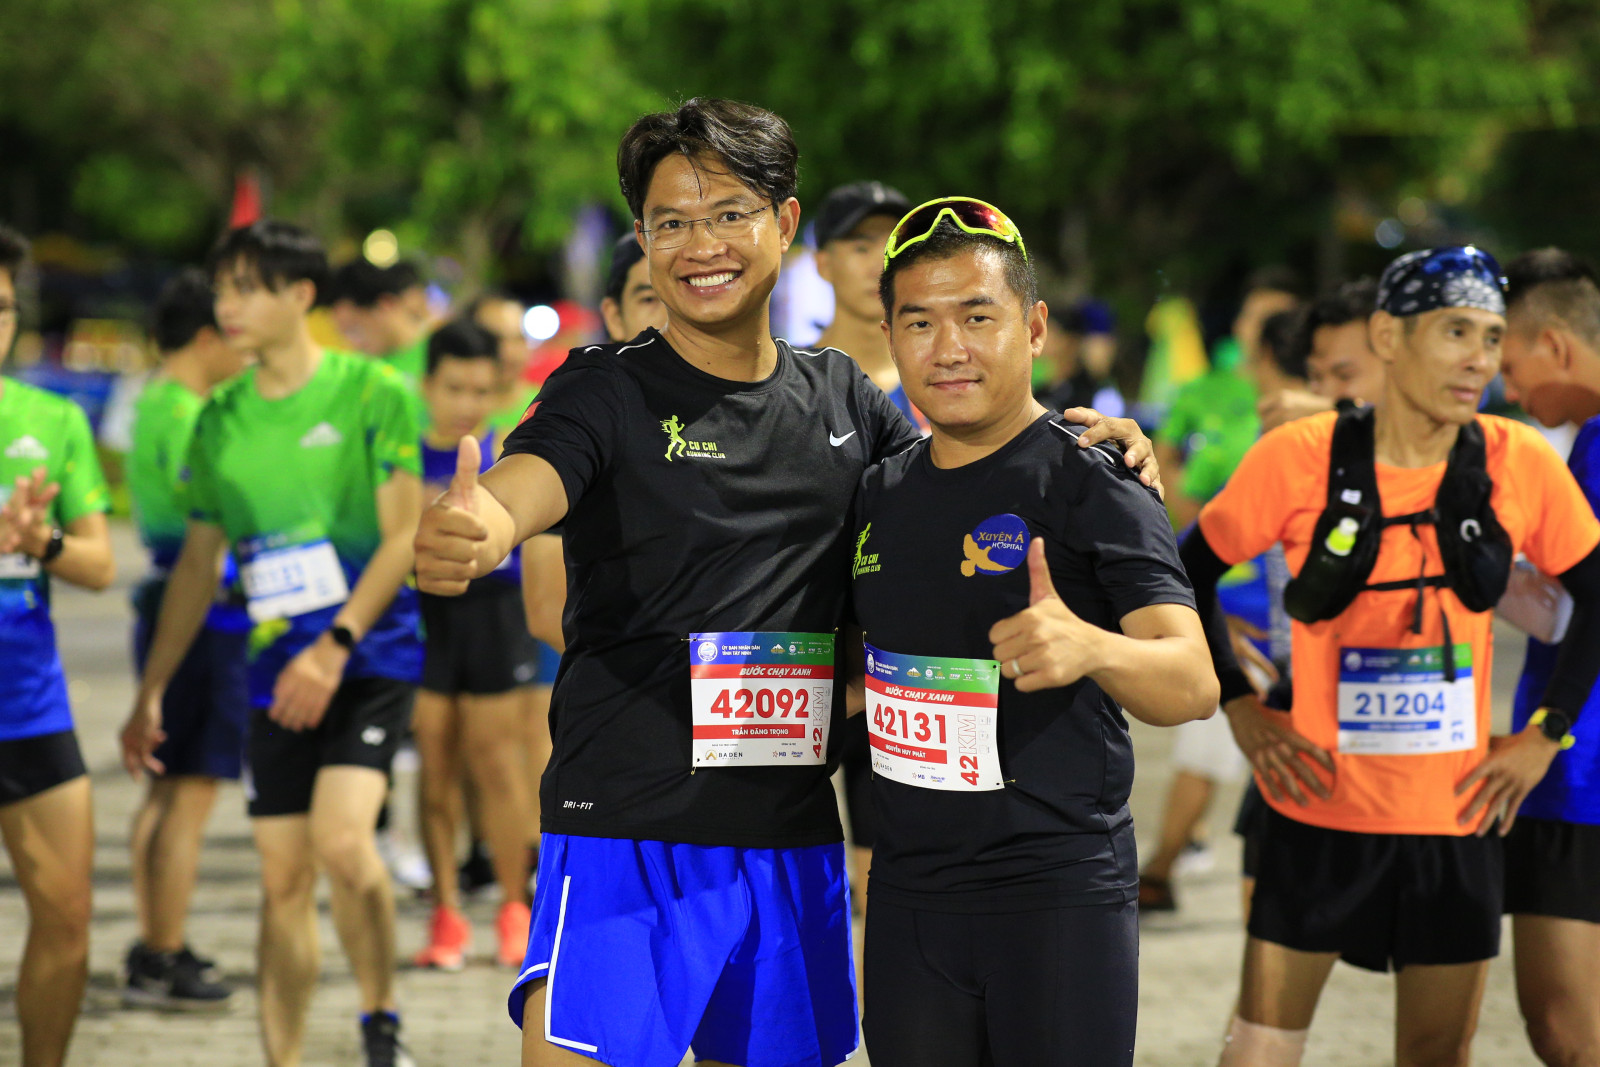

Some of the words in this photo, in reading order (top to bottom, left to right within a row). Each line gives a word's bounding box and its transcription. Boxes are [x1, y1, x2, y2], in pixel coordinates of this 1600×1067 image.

[688, 440, 700, 450] CU
[702, 442, 718, 451] CHI
[978, 532, 1012, 542] XUYÊN
[1014, 531, 1024, 544] Á
[992, 542, 1023, 550] HOSPITAL
[739, 665, 766, 676] BƯỚC
[767, 668, 790, 678] CHẠY
[790, 668, 812, 676] XANH
[904, 690, 927, 701] CHẠY
[927, 692, 955, 702] XANH
[710, 688, 809, 719] 42092
[1354, 690, 1446, 716] 21204
[874, 703, 946, 744] 42131
[770, 728, 789, 736] TRỌNG
[563, 800, 594, 810] DRI-FIT
